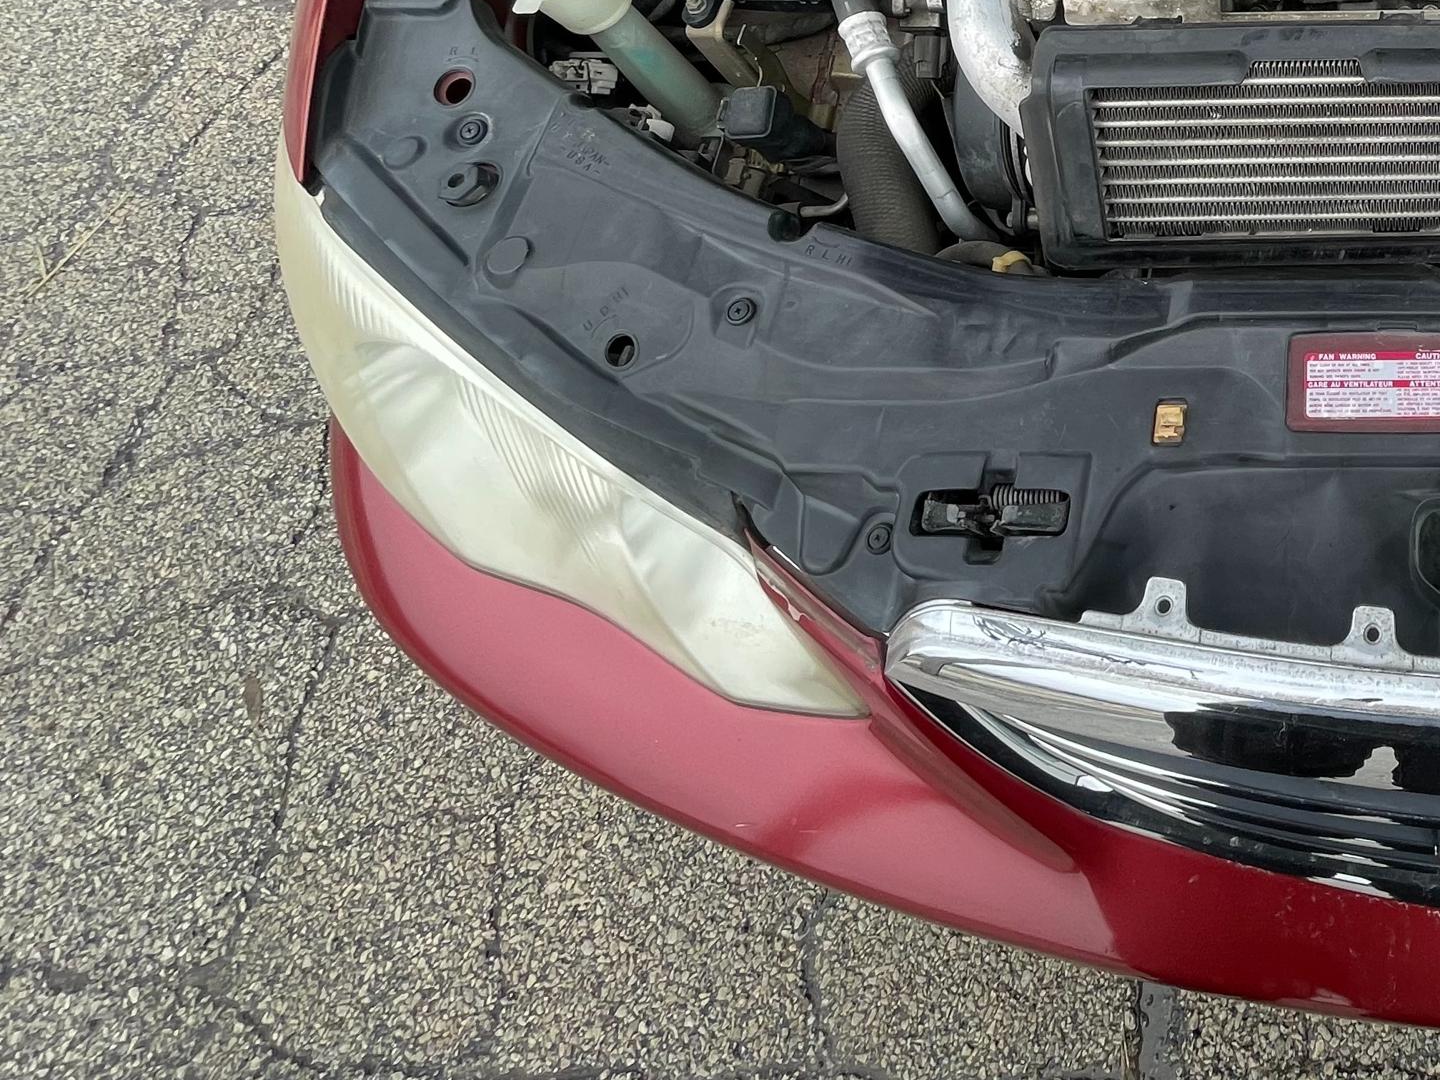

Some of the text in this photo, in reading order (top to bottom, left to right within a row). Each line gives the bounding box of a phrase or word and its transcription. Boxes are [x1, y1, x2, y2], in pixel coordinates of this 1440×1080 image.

[805, 244, 816, 256] R
[822, 249, 831, 260] L
[1343, 380, 1394, 388] VENTILATEUR
